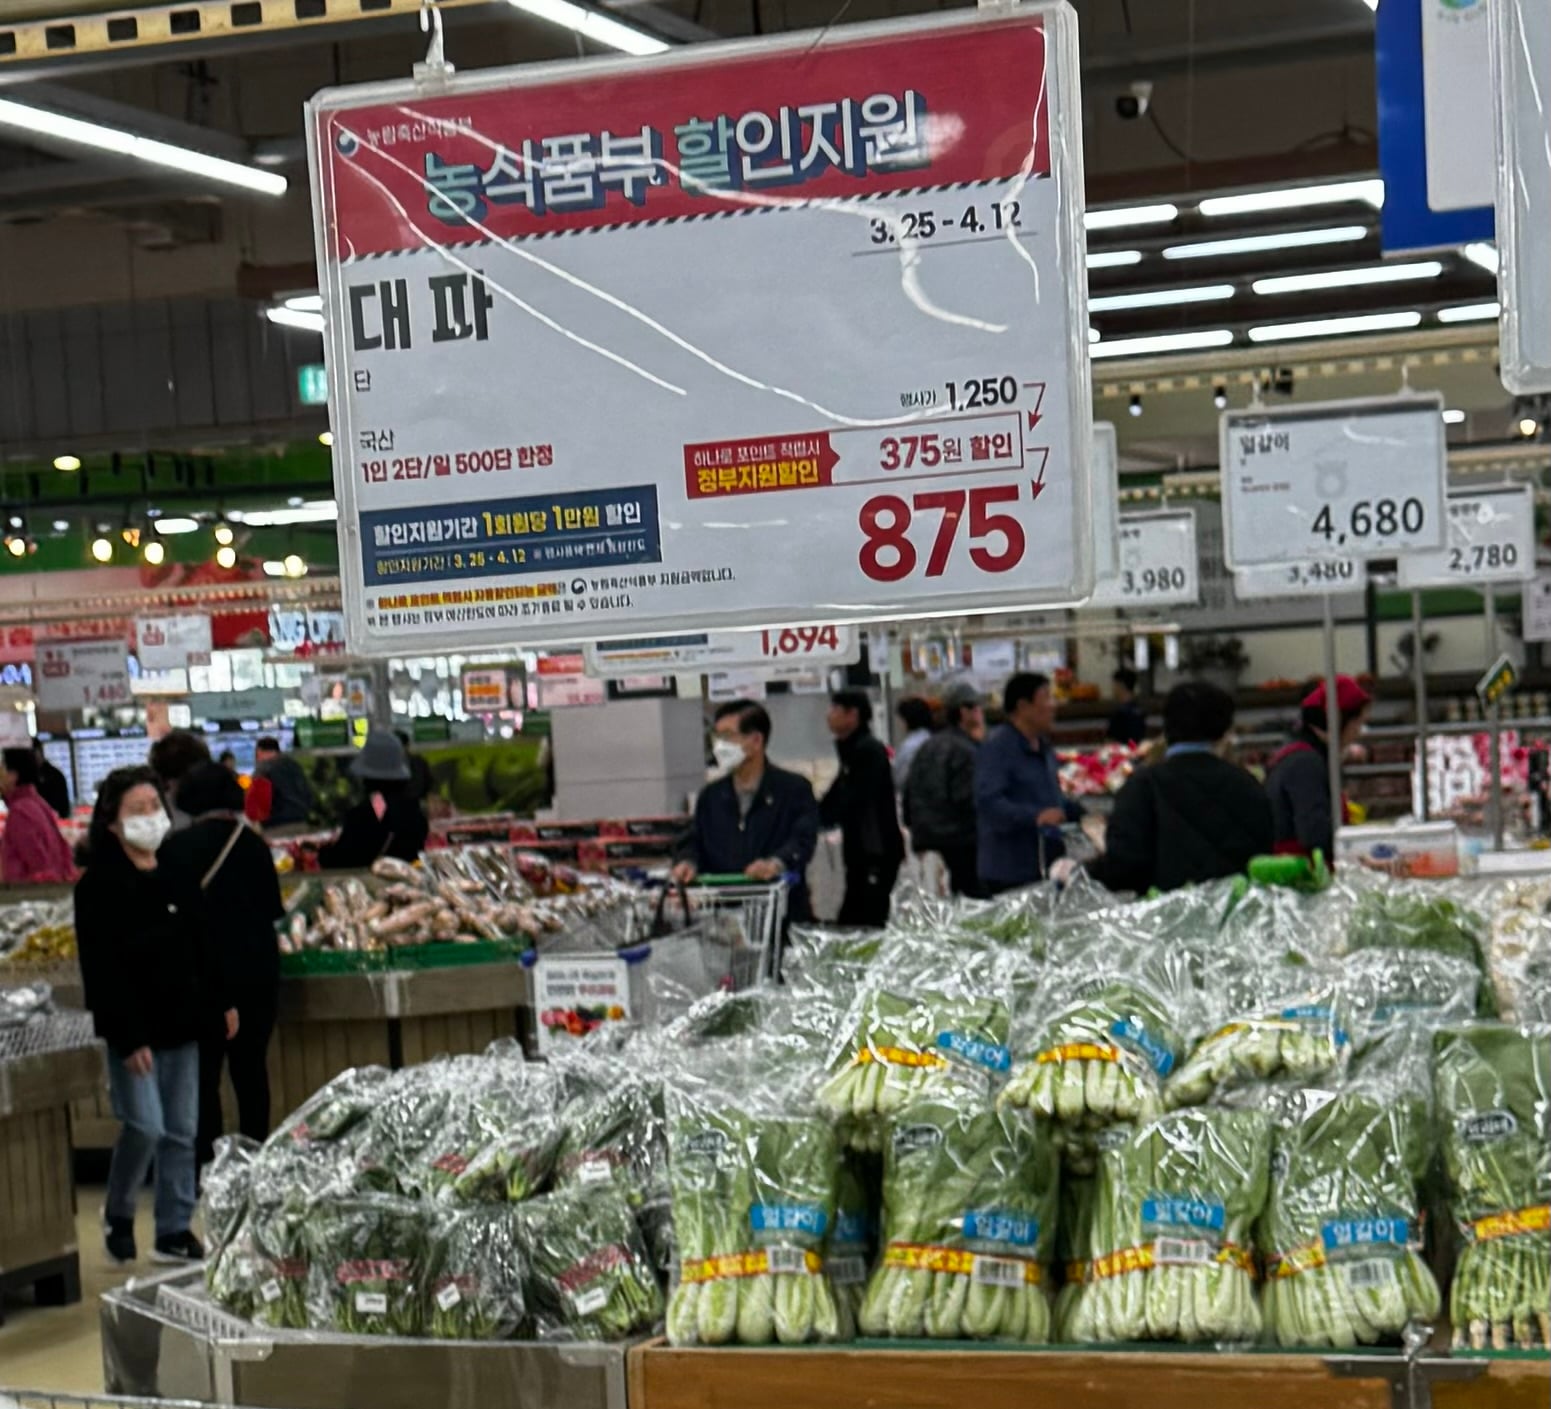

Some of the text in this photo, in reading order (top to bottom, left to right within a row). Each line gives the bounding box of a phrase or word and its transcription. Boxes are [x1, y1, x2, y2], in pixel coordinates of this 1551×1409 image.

[424, 89, 919, 220] 농식품부 할인지원
[354, 369, 371, 392] 단
[945, 376, 1018, 411] 1,250
[360, 429, 394, 451] 국산
[879, 431, 1014, 471] 375원 할인
[456, 447, 512, 474] 500단
[697, 458, 819, 494] 정부지원할인
[373, 516, 478, 547] 할인지원기간
[605, 501, 641, 525] 할인
[858, 484, 1026, 583] 875
[1311, 498, 1425, 545] 4,680
[1449, 544, 1517, 574] 2,780
[1122, 568, 1185, 595] 3,980
